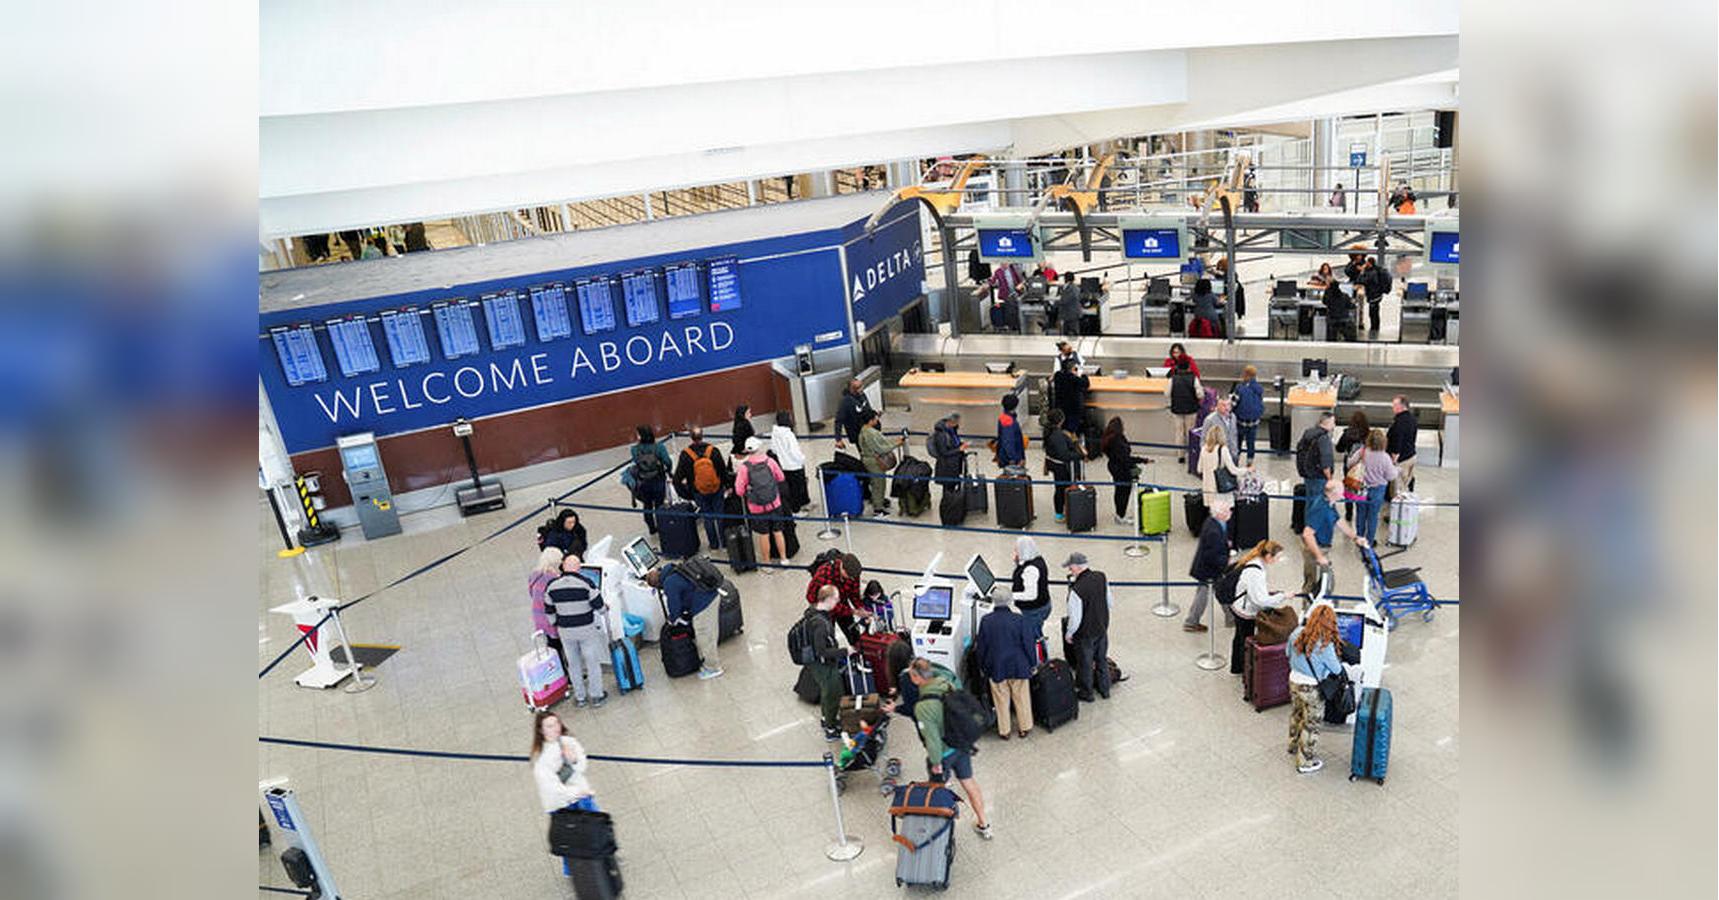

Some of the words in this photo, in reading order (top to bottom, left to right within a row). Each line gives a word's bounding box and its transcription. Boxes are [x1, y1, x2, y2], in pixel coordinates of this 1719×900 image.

[866, 248, 911, 291] DELTA
[314, 353, 554, 424] WELCOME
[571, 321, 734, 378] ABOARD
